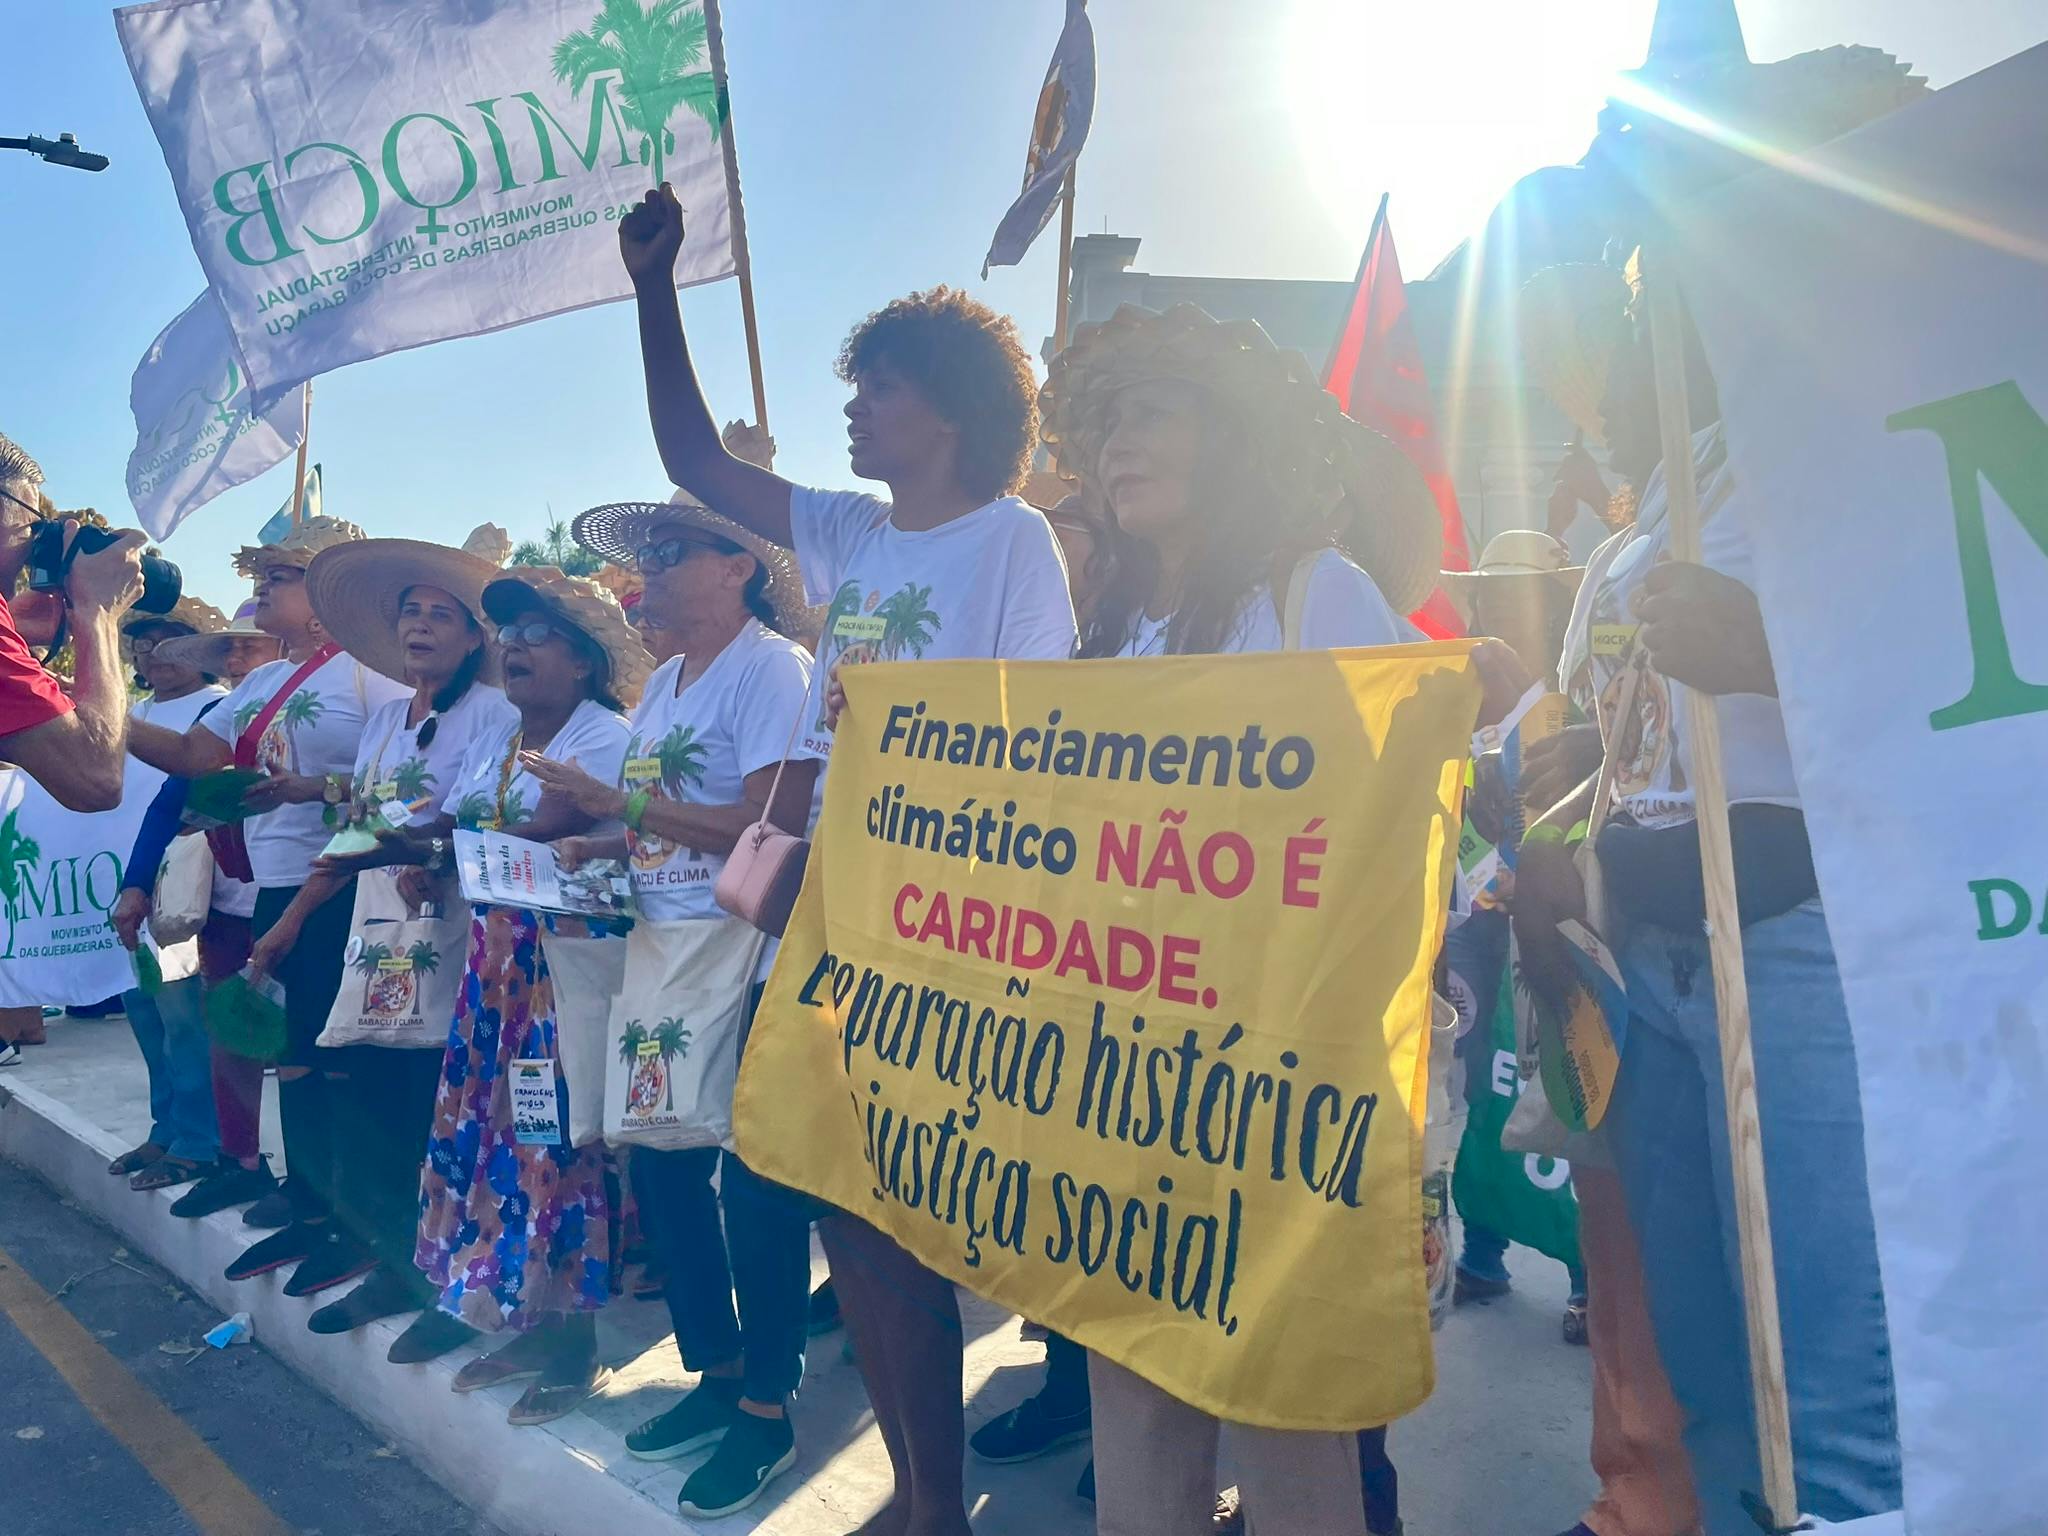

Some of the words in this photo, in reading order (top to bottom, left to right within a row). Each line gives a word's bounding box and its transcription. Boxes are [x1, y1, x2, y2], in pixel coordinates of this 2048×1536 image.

[879, 700, 1315, 790] Financiamento
[656, 869, 665, 885] É
[668, 867, 710, 884] CLIMA
[866, 783, 1077, 875] climático
[1096, 807, 1255, 900] NÃO
[1282, 817, 1328, 908] É
[20, 946, 39, 958] DAS
[41, 938, 113, 956] QUEBRADEIRAS
[51, 923, 103, 940] MOVIMENTO
[893, 882, 1219, 1010] CARIDADE.
[1076, 1000, 1378, 1208] histórica
[866, 1080, 1032, 1268] justiça
[1045, 1175, 1243, 1336] social.
